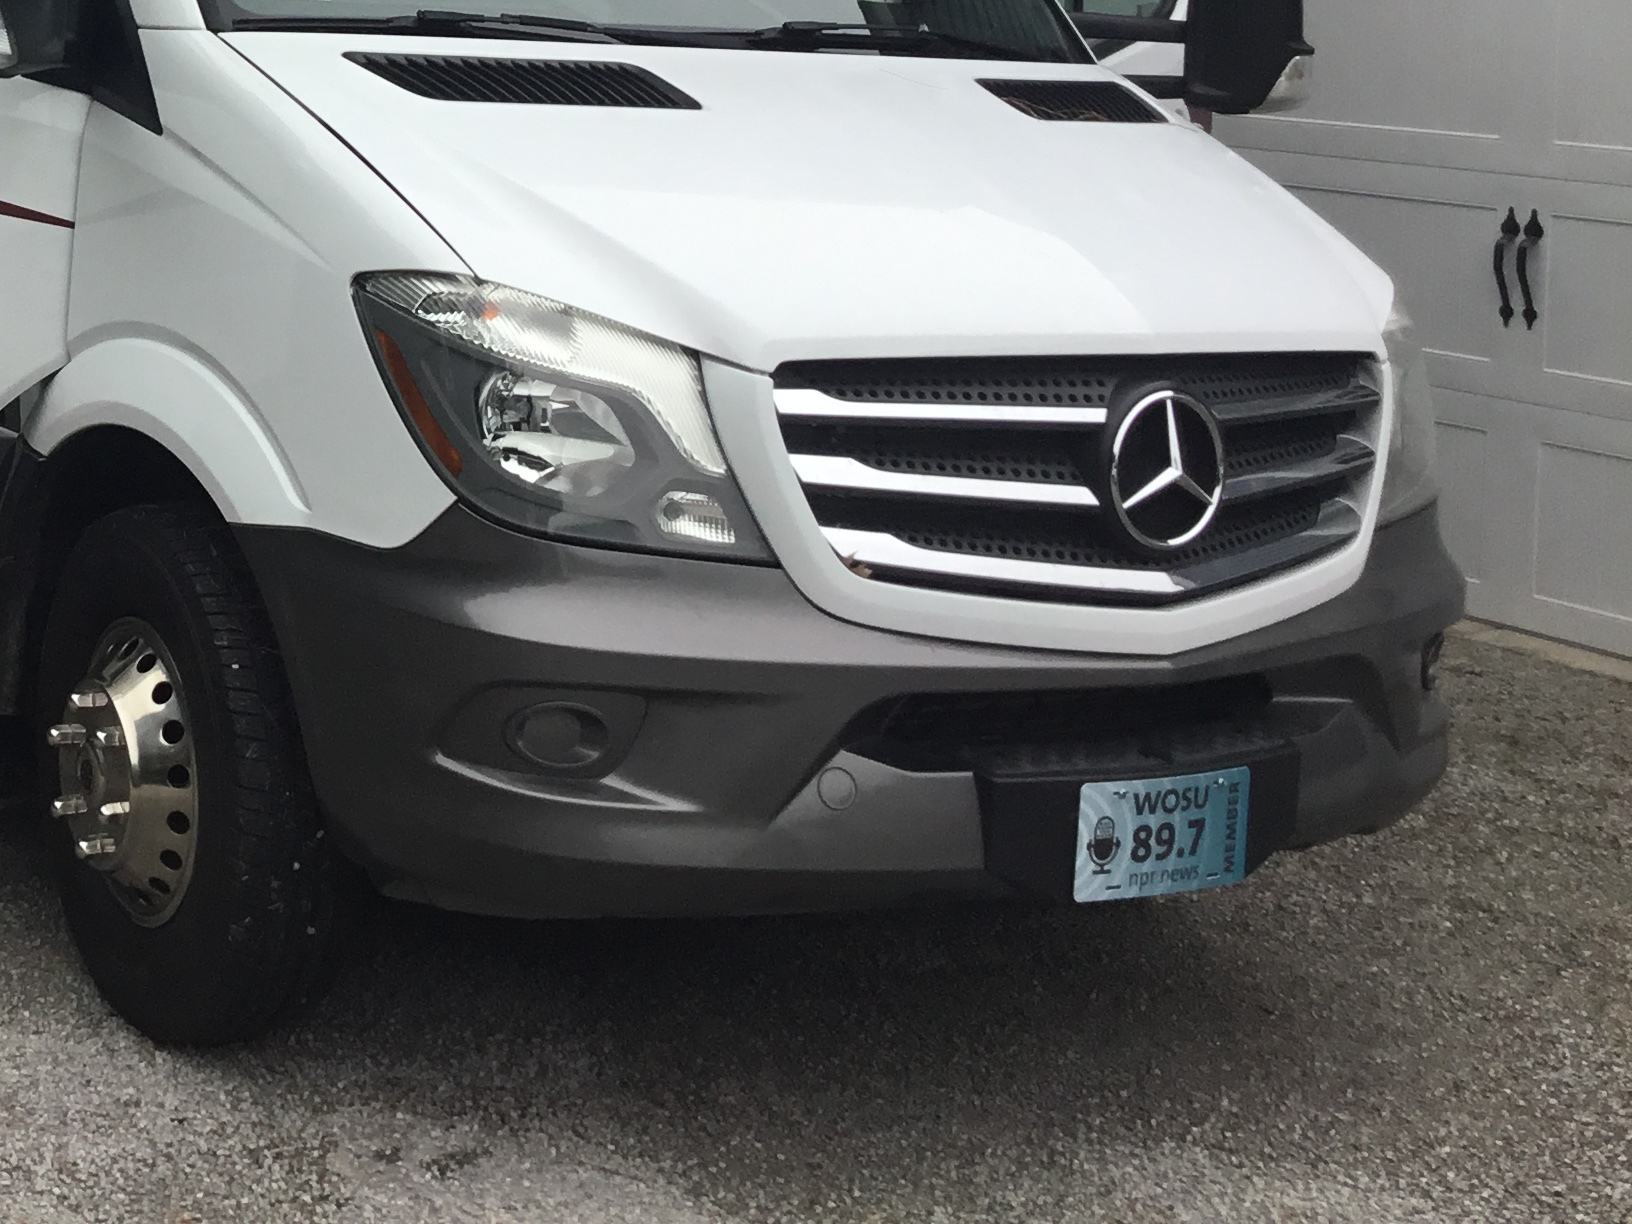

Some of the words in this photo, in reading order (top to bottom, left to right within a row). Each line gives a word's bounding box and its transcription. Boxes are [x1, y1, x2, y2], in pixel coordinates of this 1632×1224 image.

[1133, 785, 1210, 815] WOSU
[1130, 817, 1206, 863] 89.7
[1223, 781, 1241, 873] MEMBER
[1128, 870, 1157, 891] npr
[1159, 864, 1200, 883] news
